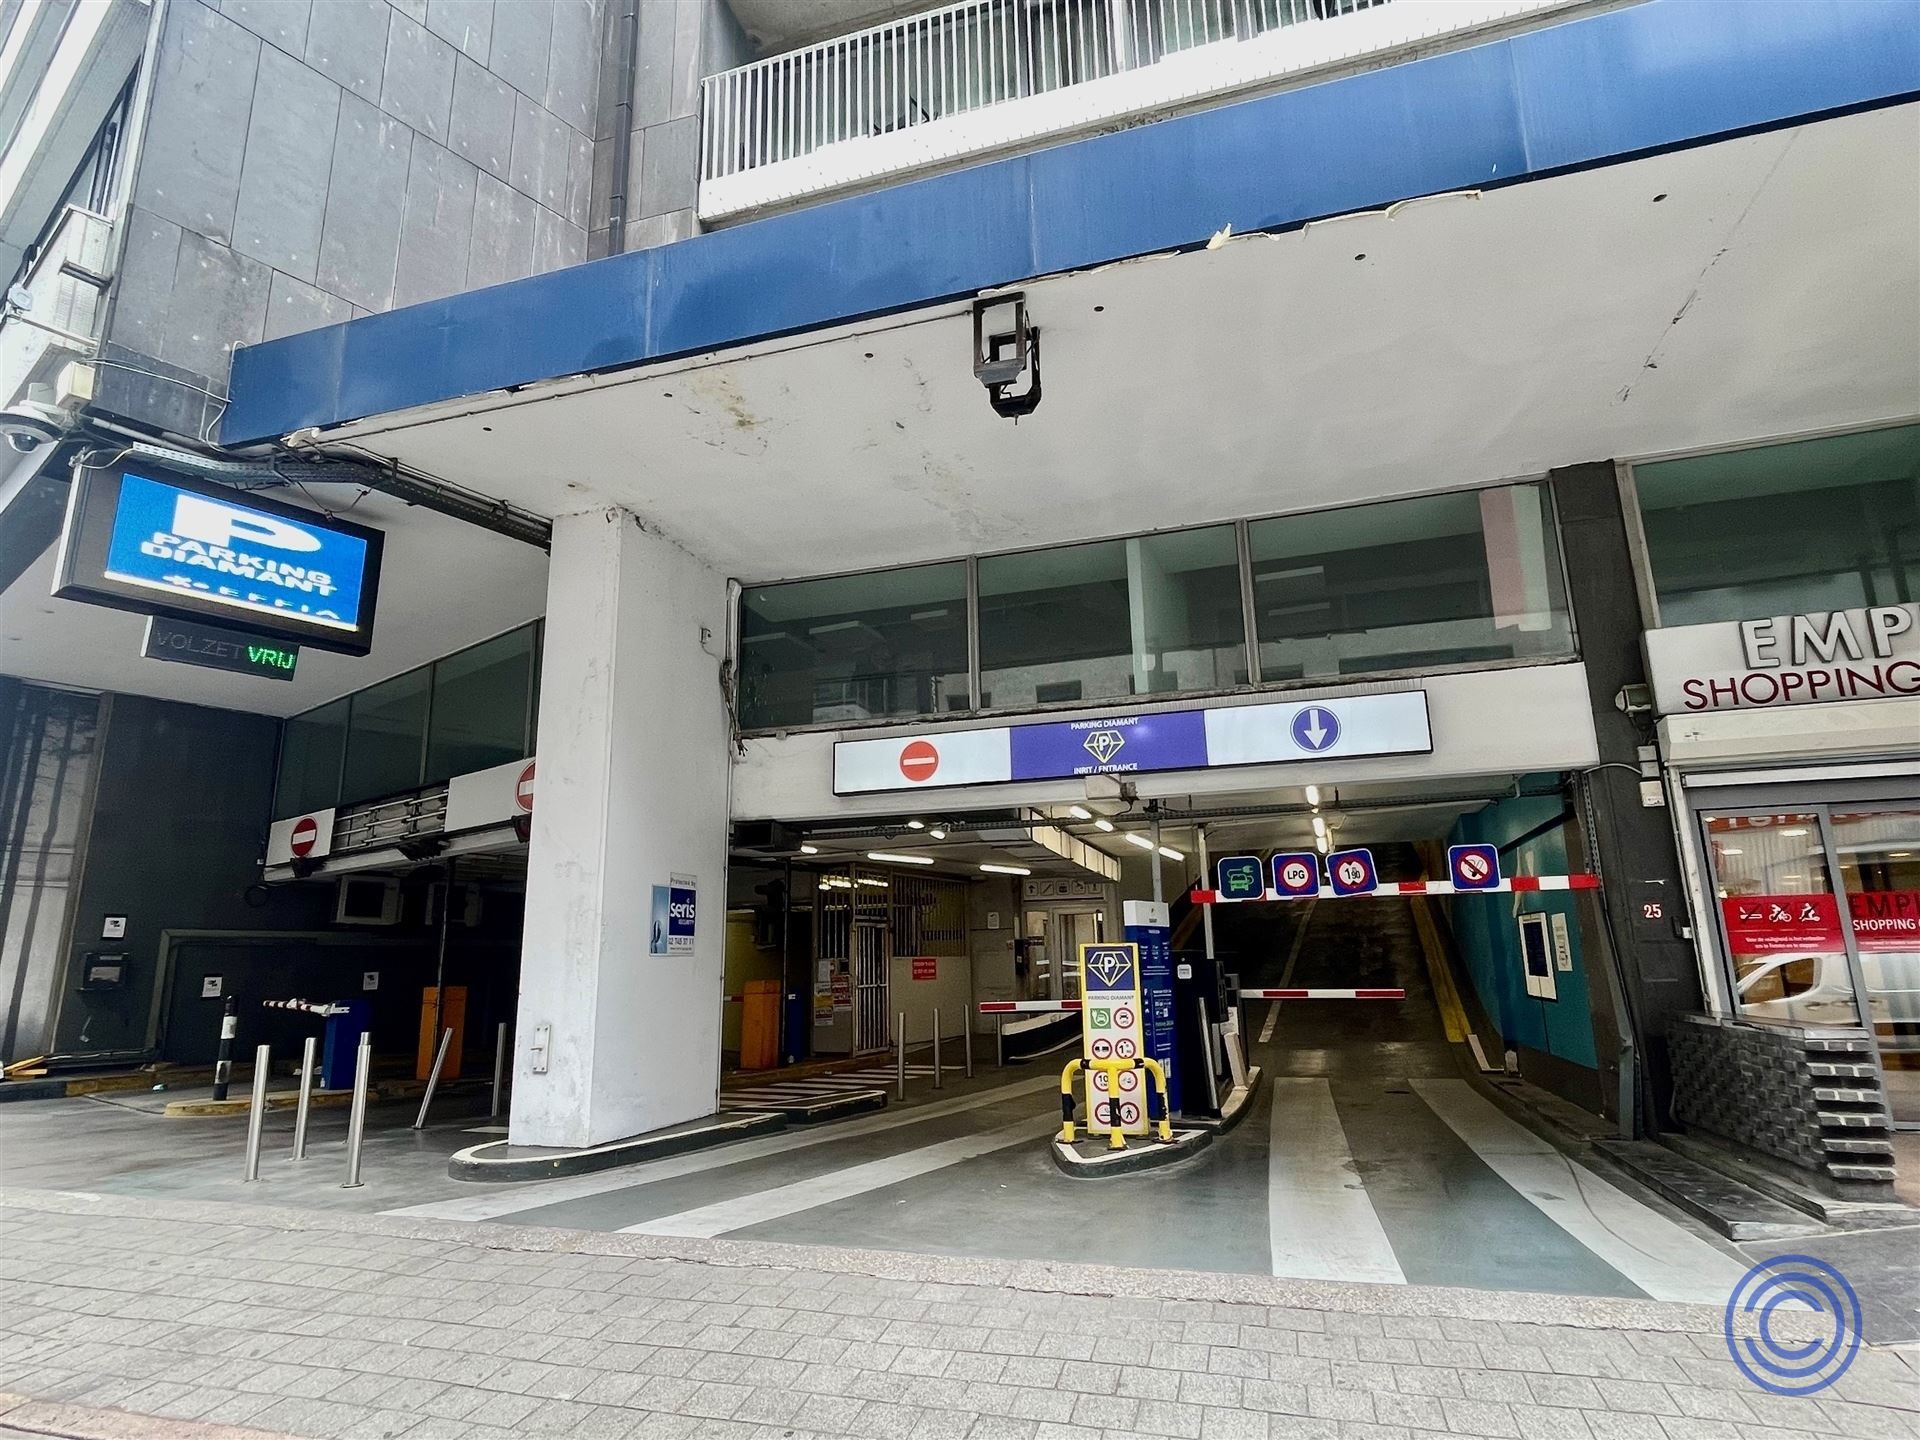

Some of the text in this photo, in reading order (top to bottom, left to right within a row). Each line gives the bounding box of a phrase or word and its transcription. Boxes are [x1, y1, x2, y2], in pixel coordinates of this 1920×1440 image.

[172, 494, 322, 551] P
[152, 532, 332, 583] PARKING
[141, 541, 337, 596] DIAMANT
[157, 631, 294, 669] VOLZET VRIJ
[1683, 661, 1920, 710] SHOPPING
[1070, 717, 1138, 730] PARKING DIAMANT
[1098, 735, 1110, 751] P
[1073, 766, 1093, 775] INRIT
[1098, 763, 1138, 773] ENTRANCE
[1287, 869, 1305, 880] LPG
[670, 898, 695, 918] seris
[1643, 903, 1662, 919] 25
[1853, 918, 1917, 930] SHOPPING
[1104, 956, 1116, 973] P
